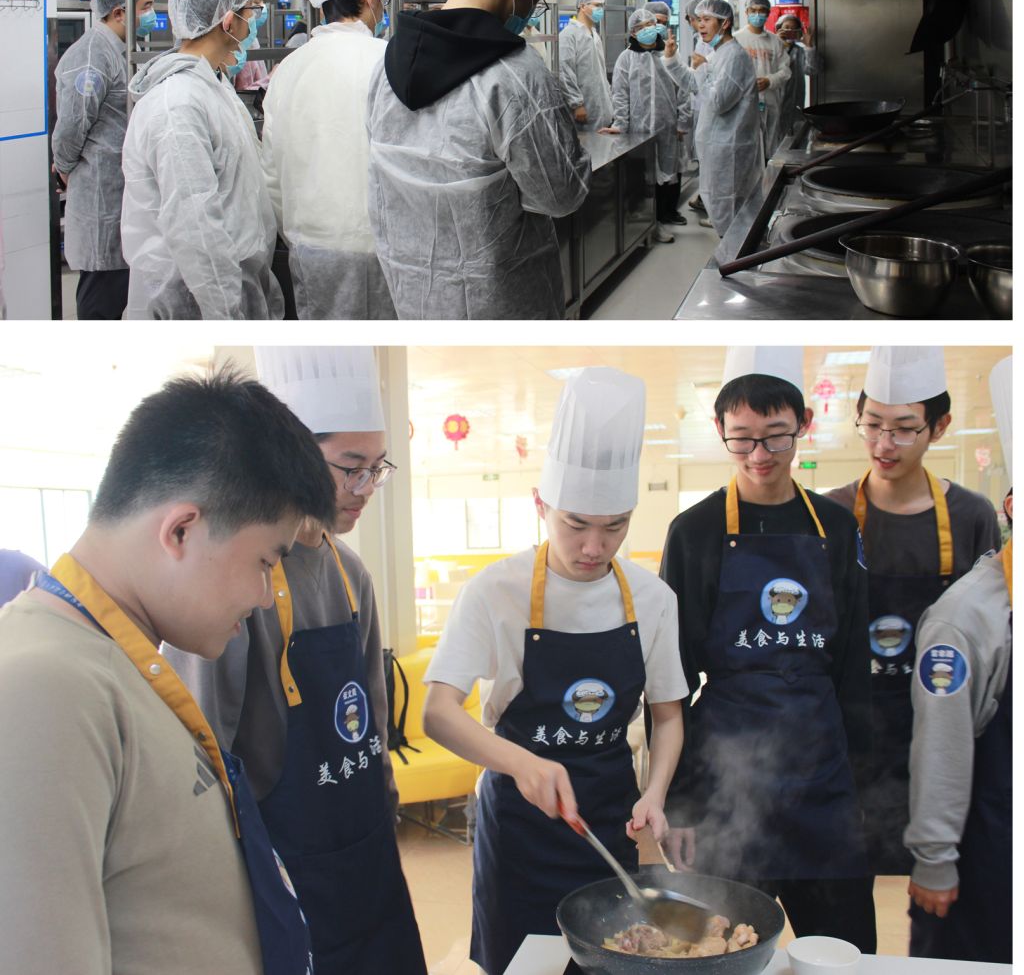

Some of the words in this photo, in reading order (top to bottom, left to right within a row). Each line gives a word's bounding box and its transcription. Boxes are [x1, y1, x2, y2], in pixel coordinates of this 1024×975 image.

[735, 628, 826, 649] 美食与生活
